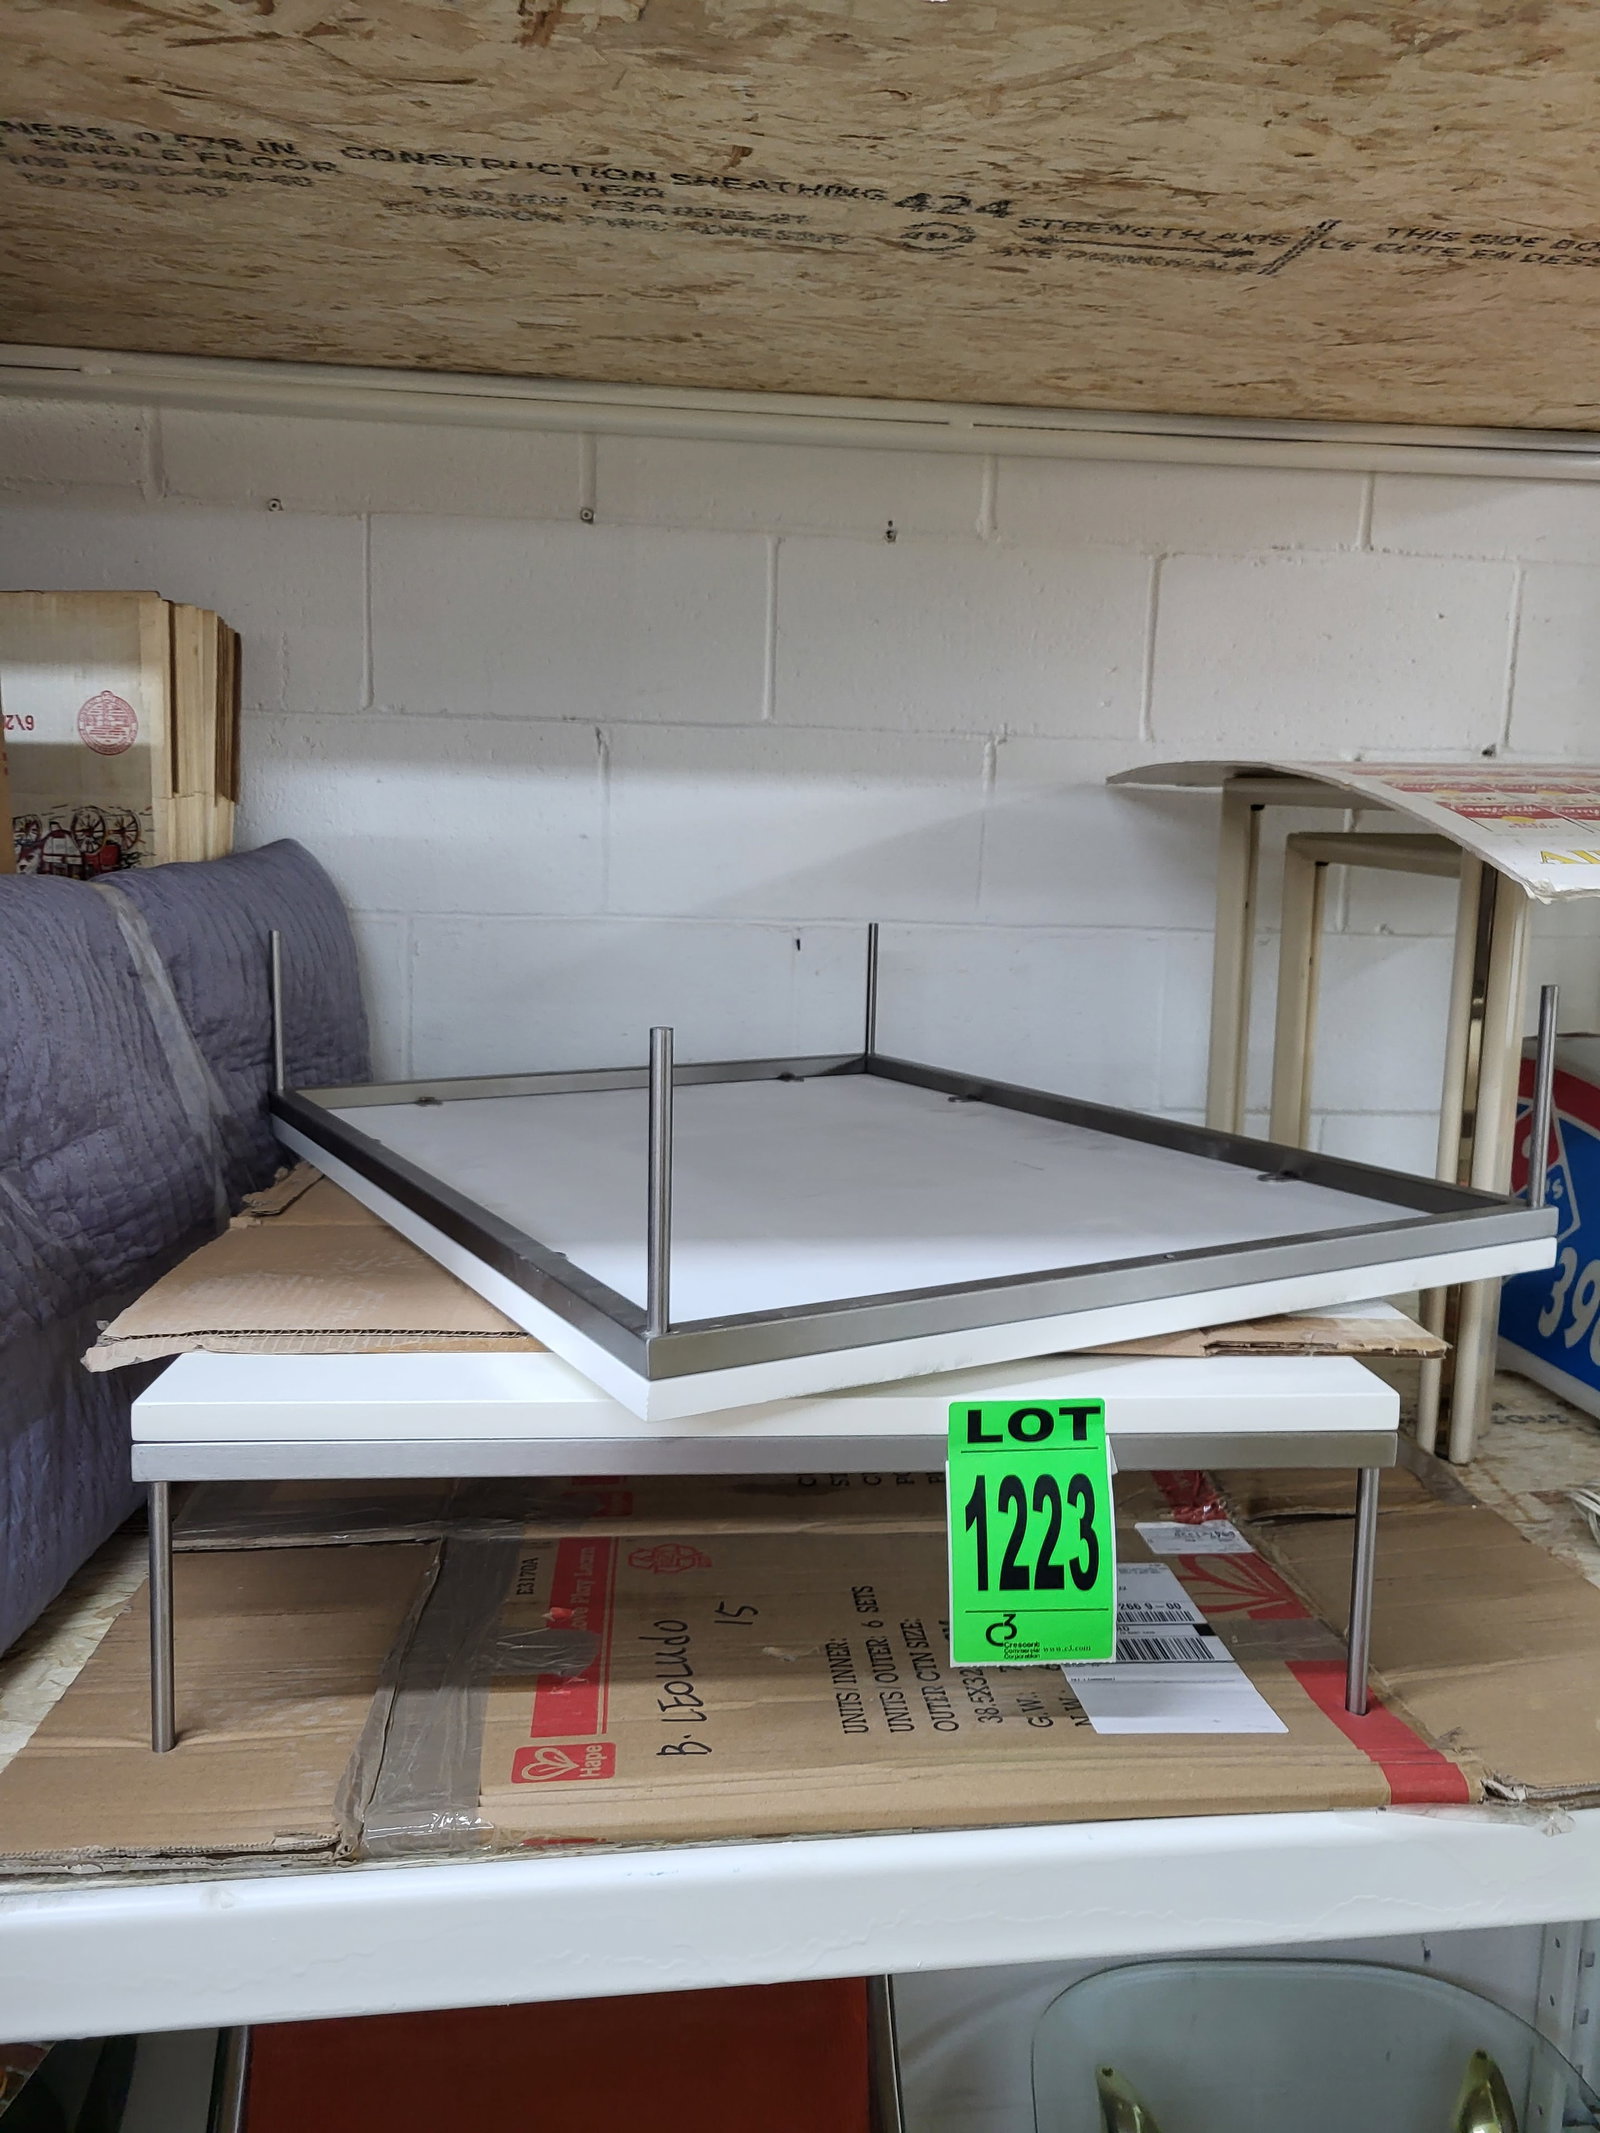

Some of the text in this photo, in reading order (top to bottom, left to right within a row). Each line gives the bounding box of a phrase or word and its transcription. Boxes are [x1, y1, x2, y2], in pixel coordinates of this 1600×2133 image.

[29, 138, 185, 162] SINGLE
[196, 151, 345, 175] FLOOR
[340, 145, 1014, 219] CONSTRUCTION SHEATHING 424
[1017, 217, 1208, 241] STRENGTH
[1387, 226, 1462, 243] THIS
[1468, 233, 1547, 248] SIDE
[967, 1406, 1101, 1444] LOT
[965, 1472, 1099, 1592] 1223
[516, 1556, 540, 1596] E3170A
[713, 1600, 760, 1626] 15
[852, 1585, 880, 1613] SETS
[861, 1619, 885, 1629] 6
[900, 1618, 960, 1732] OUTER CTN SIZE:
[578, 1744, 603, 1778] Hape
